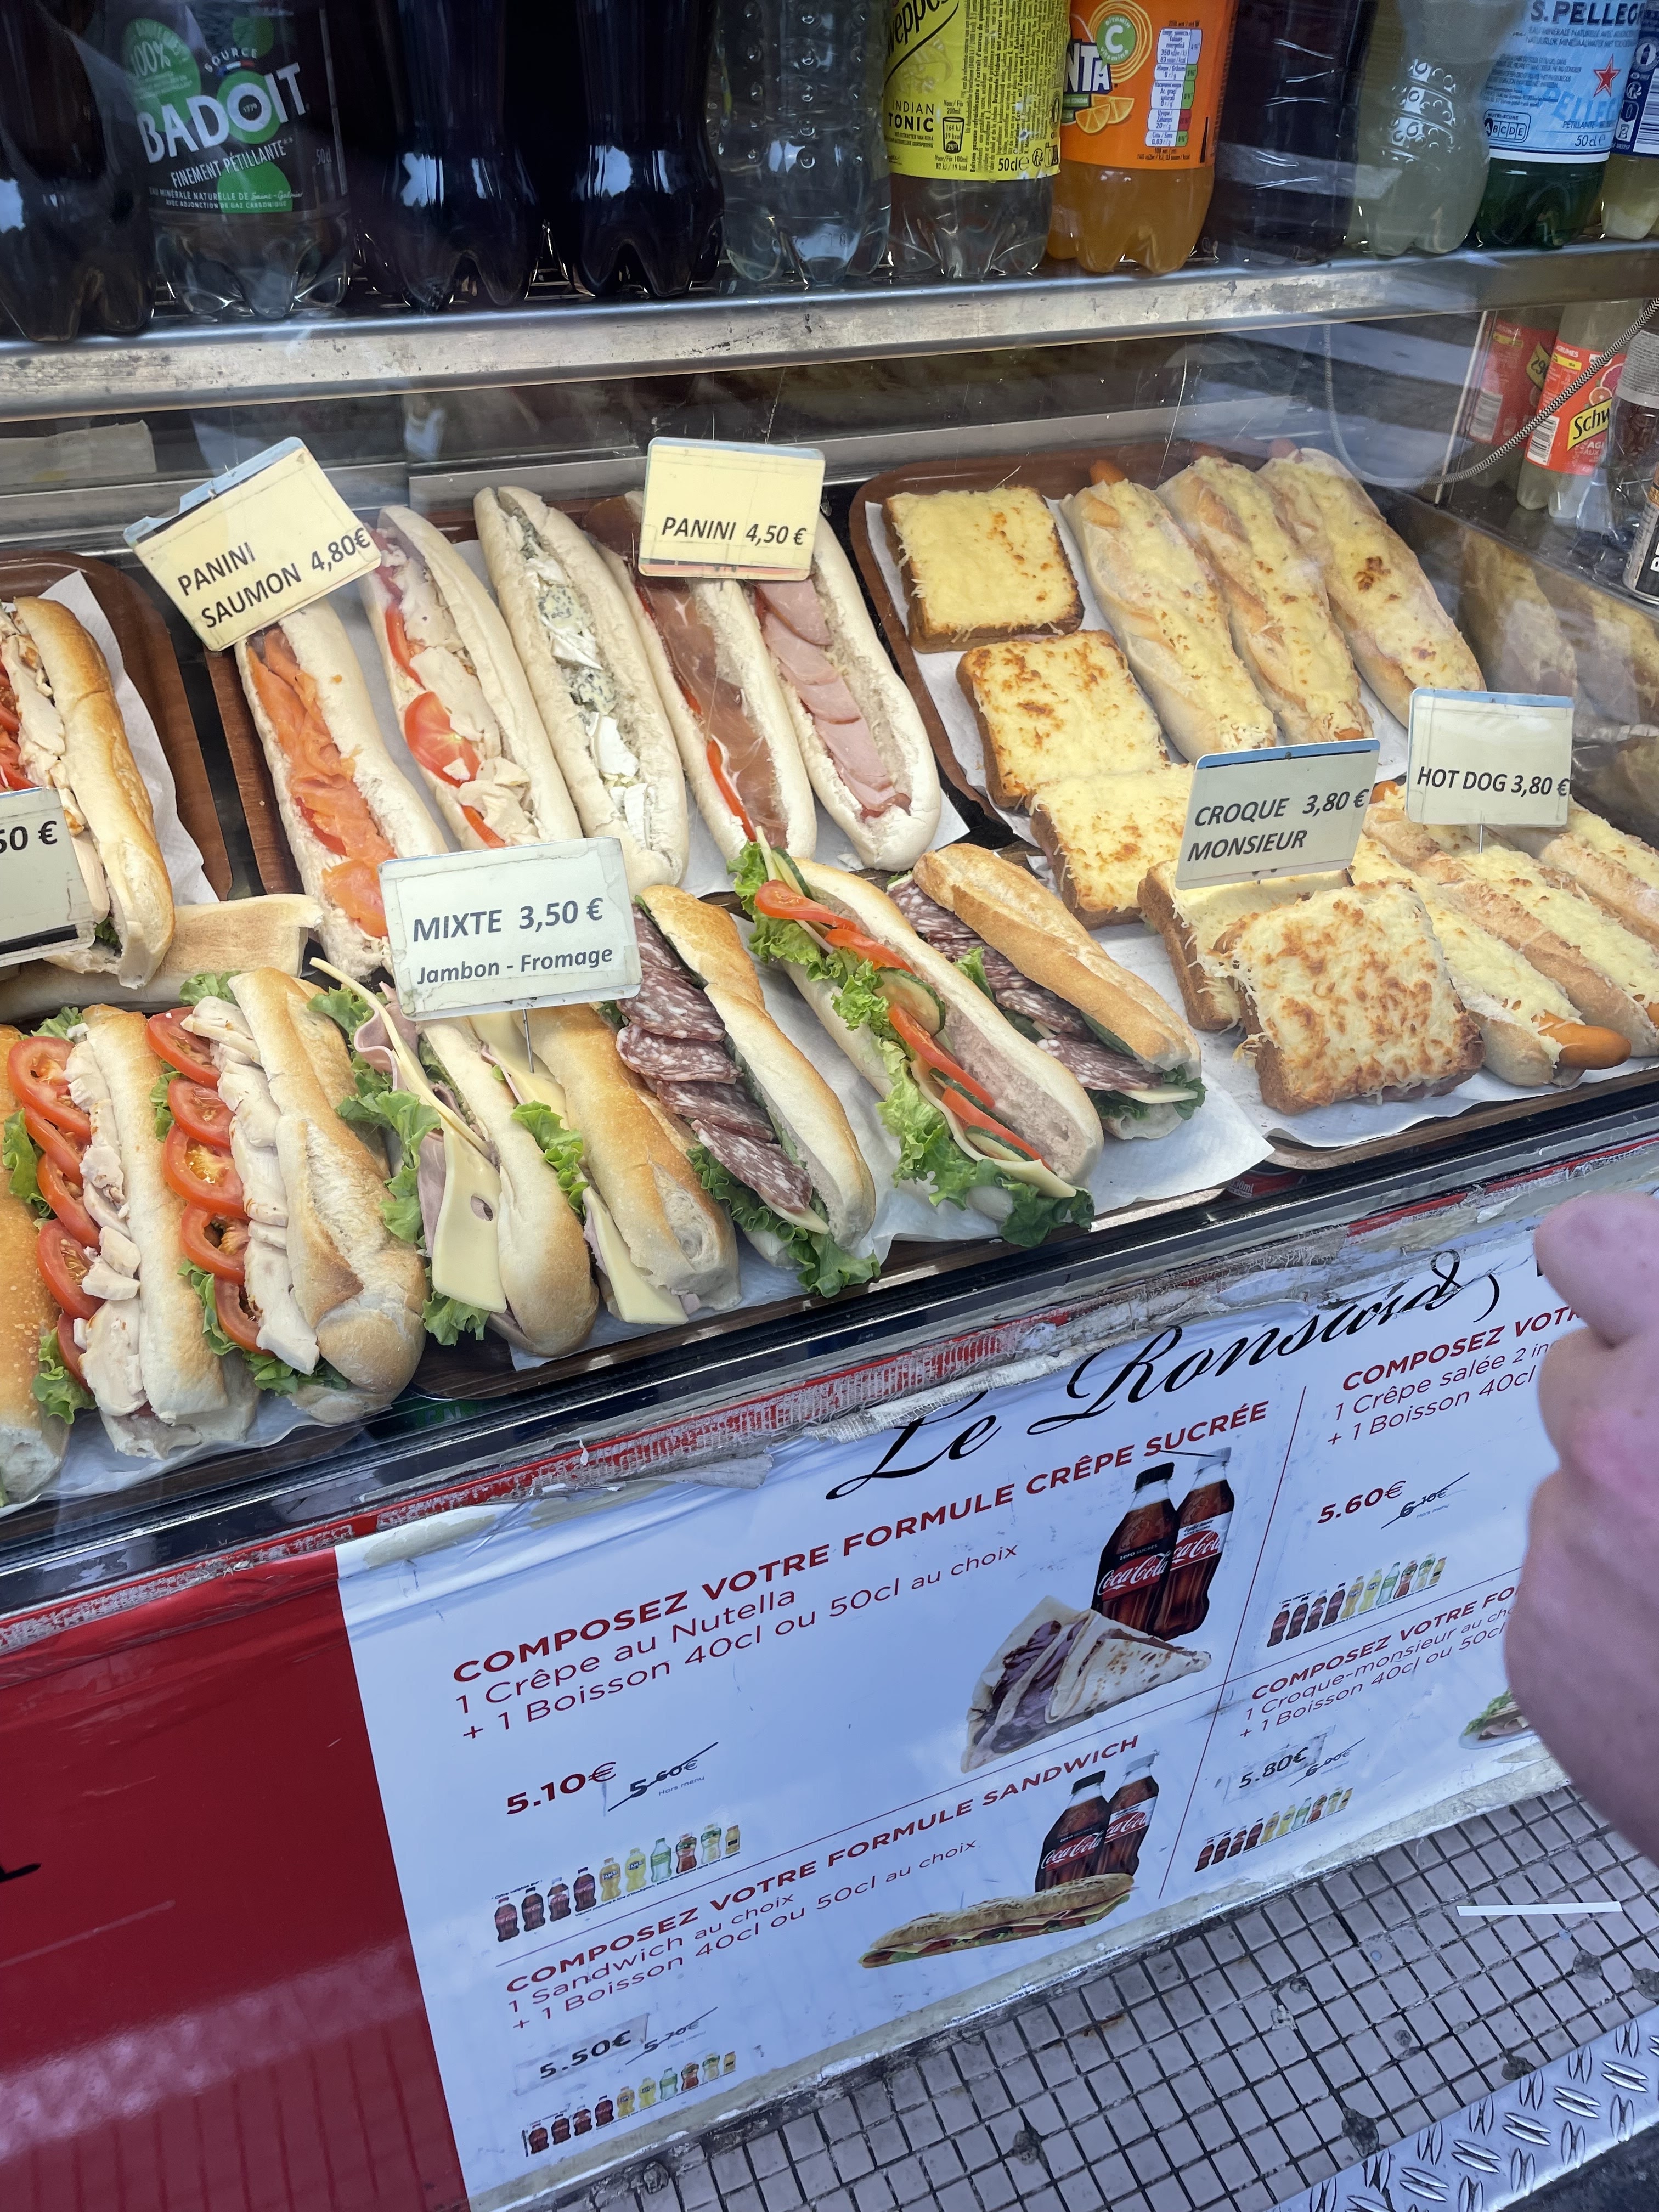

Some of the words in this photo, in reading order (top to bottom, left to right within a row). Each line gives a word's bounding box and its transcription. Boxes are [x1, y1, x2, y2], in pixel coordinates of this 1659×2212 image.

[204, 47, 257, 73] SOURCE
[1105, 25, 1124, 54] C
[137, 61, 306, 163] BADOIT
[888, 112, 934, 133] TONIC
[171, 160, 221, 188] FINEMENT
[193, 192, 236, 201] NATURELLE
[238, 193, 249, 201] DE
[180, 199, 219, 209] ADJONCTION
[661, 517, 737, 541] PANINI
[746, 523, 789, 546] 4,50
[793, 527, 807, 546] €
[177, 541, 256, 597] PANINI
[201, 562, 302, 628] SAUMON
[311, 527, 371, 572] 4,80€
[1194, 797, 1290, 827] CROQUE
[1302, 791, 1350, 817] 3,80
[1353, 788, 1369, 808] €
[1417, 766, 1460, 788] HOT
[1462, 771, 1508, 792] DOG
[1510, 775, 1553, 797] 3,80
[1556, 778, 1570, 796] €
[38, 820, 58, 845] €
[1187, 829, 1308, 862] MONSIEUR
[413, 909, 503, 943] MIXTE
[518, 900, 579, 933] 3,50
[586, 897, 604, 921] €
[417, 960, 500, 985] Jambon
[521, 948, 613, 973] Fromage
[826, 1390, 1002, 1500] Le
[1026, 1248, 1500, 1435] Ronsard
[1336, 1403, 1345, 1421] 1
[1353, 1378, 1431, 1415] Crêpe
[1439, 1355, 1505, 1387] salée
[1512, 1348, 1527, 1364] 2
[1342, 1325, 1505, 1391] COMPOSEZ
[1328, 1433, 1342, 1445] +
[1353, 1423, 1361, 1441] 1
[1369, 1391, 1470, 1435] Boisson
[1479, 1364, 1537, 1396] 40cl
[1317, 1480, 1407, 1524] 5.60€
[454, 1590, 689, 1683] COMPOSEZ
[702, 1544, 830, 1600] VOTRE
[843, 1483, 1015, 1557] FORMULE
[1026, 1444, 1135, 1494] CRÊPE
[1144, 1400, 1269, 1457] SUCRÉE
[456, 1694, 469, 1714] 1
[486, 1656, 600, 1703] Crêpe
[614, 1636, 657, 1662] au
[673, 1590, 795, 1643] Nutella
[463, 1725, 484, 1739] +
[498, 1712, 510, 1730] 1
[527, 1660, 670, 1723] Boisson
[685, 1625, 761, 1665] 40cl
[775, 1611, 816, 1636] ou
[829, 1577, 900, 1617] 50cl
[911, 1570, 941, 1590] au
[950, 1544, 1018, 1576] choix
[1251, 1635, 1392, 1701] COMPOSEZ
[1400, 1600, 1478, 1641] VOTRE
[1482, 1585, 1519, 1609] FO
[1239, 1728, 1252, 1738] +
[1261, 1719, 1268, 1730] 1
[1276, 1684, 1363, 1726] Boisson
[1370, 1656, 1420, 1686] 40cl
[1425, 1646, 1453, 1664] ou
[1458, 1622, 1506, 1651] 50cl
[1245, 1707, 1253, 1721] 1
[1261, 1628, 1457, 1714] Croque-monsieur
[1461, 1619, 1482, 1634] au
[506, 1761, 617, 1815] 5.10€
[658, 1785, 679, 1796] Hors
[681, 1776, 704, 1788] menu
[506, 1906, 699, 1993] COMPOSEZ
[710, 1860, 817, 1912] VOTRE
[828, 1799, 974, 1867] FORMULE
[981, 1734, 1138, 1806] SANDWICH
[508, 1999, 518, 2012] 1
[532, 1937, 684, 2004] Sandwich
[694, 1922, 722, 1940] au
[731, 1894, 794, 1925] choix
[513, 2019, 530, 2029] +
[541, 2006, 551, 2019] 1
[565, 1956, 684, 2012] Boisson
[695, 1922, 759, 1957] 40cl
[770, 1906, 805, 1928] ou
[816, 1875, 876, 1911] 50cl
[885, 1865, 911, 1883] au
[919, 1839, 977, 1869] choix
[539, 2030, 633, 2080] 5.50€
